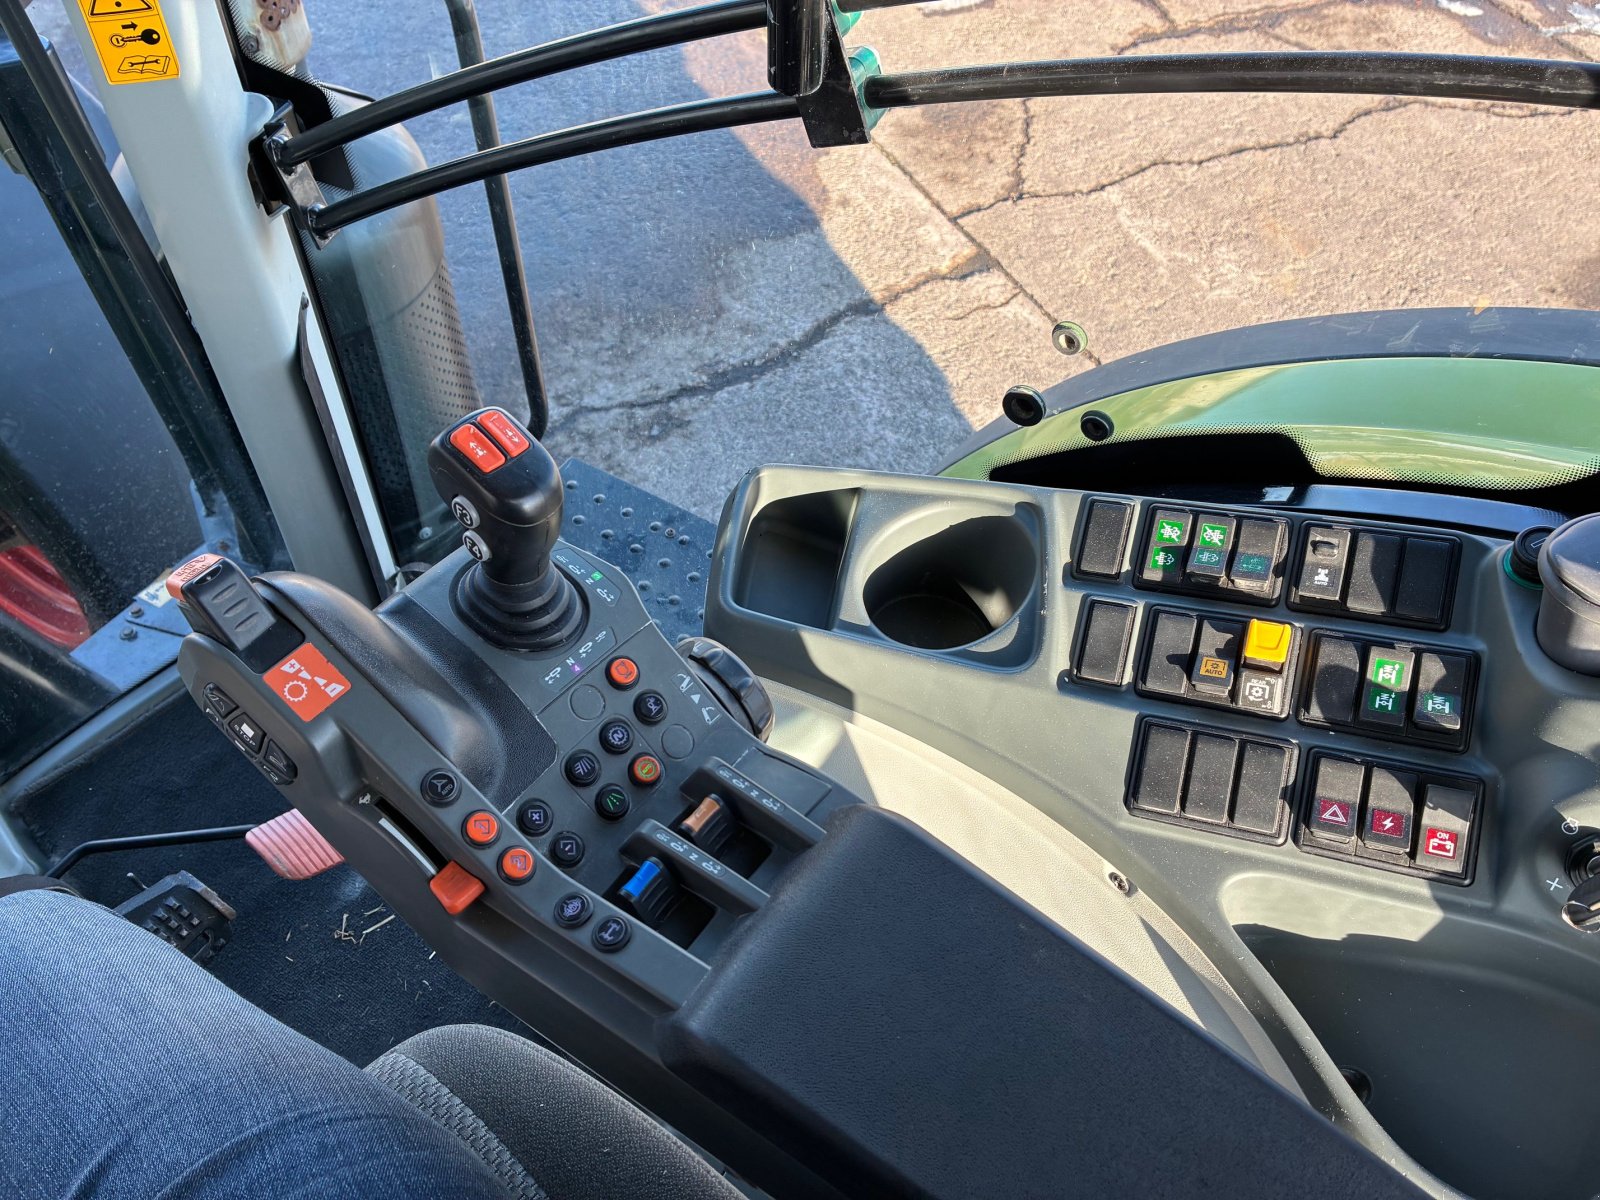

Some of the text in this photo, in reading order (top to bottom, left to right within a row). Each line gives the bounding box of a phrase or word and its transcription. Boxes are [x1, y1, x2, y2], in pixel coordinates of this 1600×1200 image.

[455, 504, 472, 525] F3
[466, 537, 481, 558] F4
[565, 657, 576, 667] N
[1204, 668, 1224, 676] AUTO
[233, 724, 257, 746] STOP
[611, 730, 624, 742] N
[441, 783, 455, 797] AUTO
[1436, 831, 1451, 840] ON
